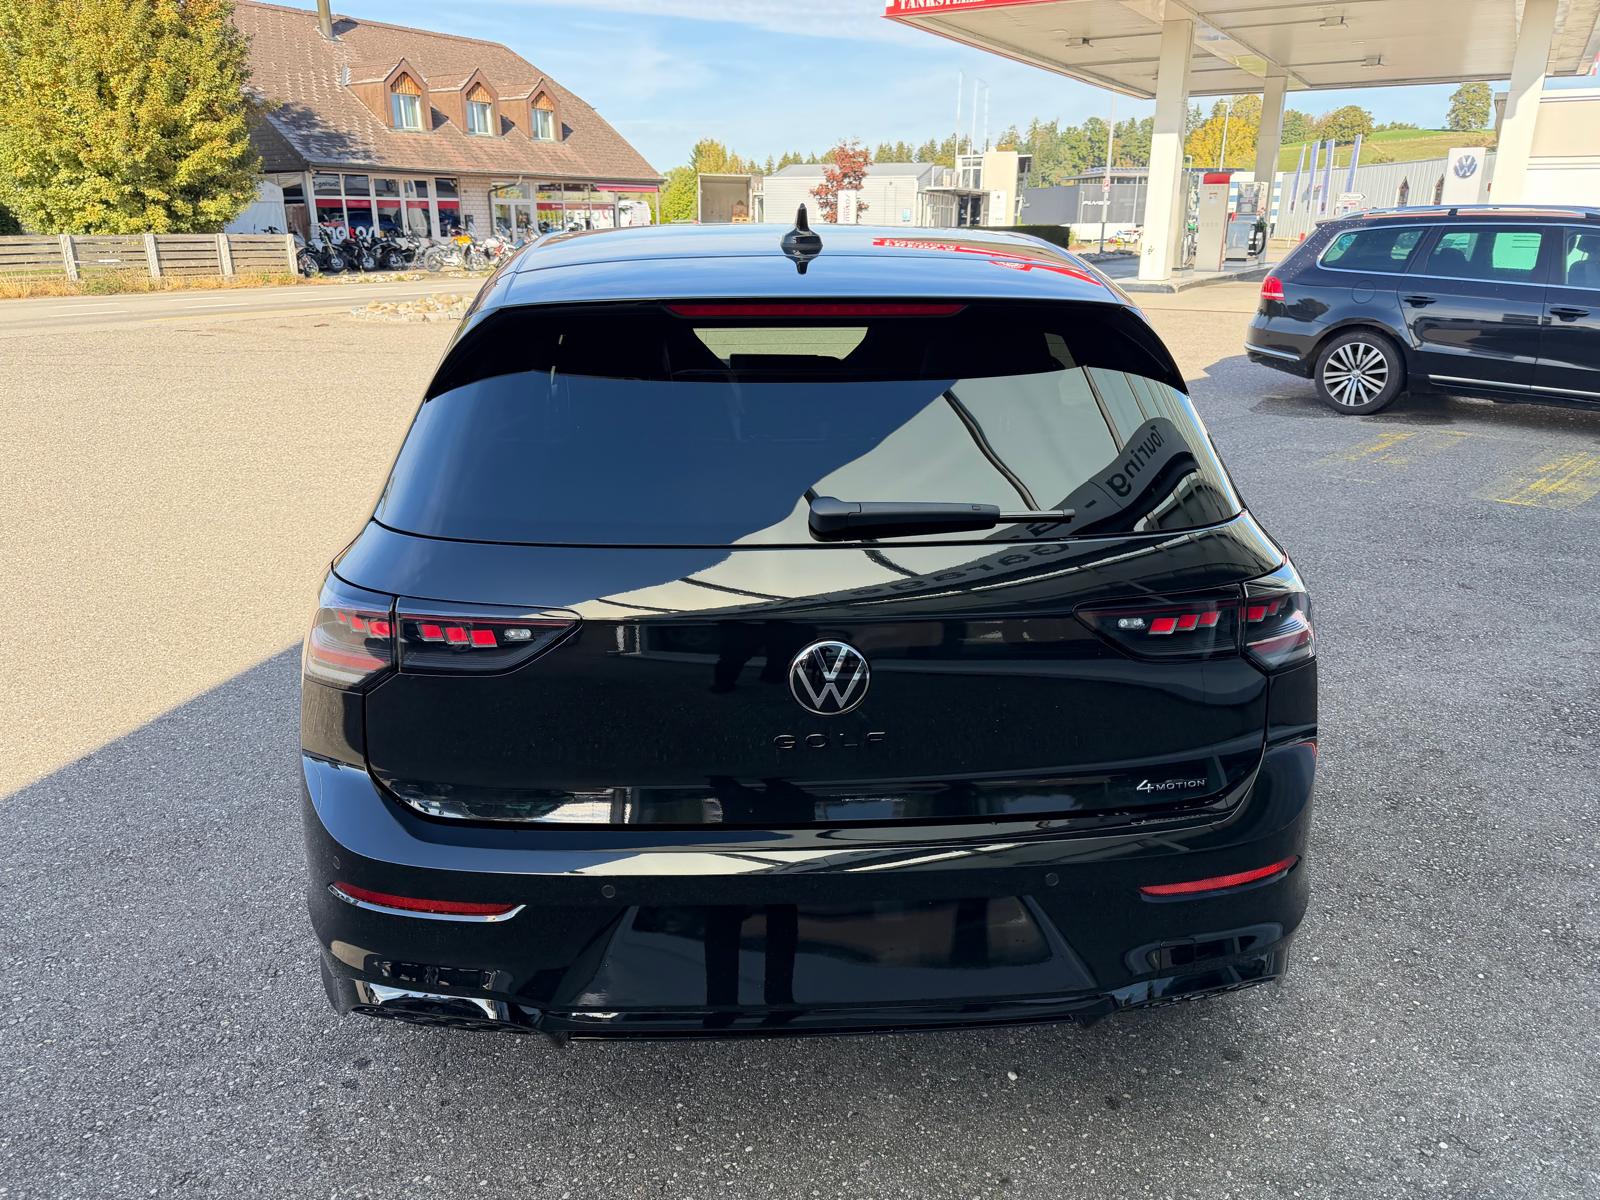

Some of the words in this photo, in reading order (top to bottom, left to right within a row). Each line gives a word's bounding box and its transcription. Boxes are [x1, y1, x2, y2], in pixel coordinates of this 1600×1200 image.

[790, 641, 871, 715] VW
[773, 731, 887, 749] GOLF
[1136, 779, 1206, 793] 4MOTION
